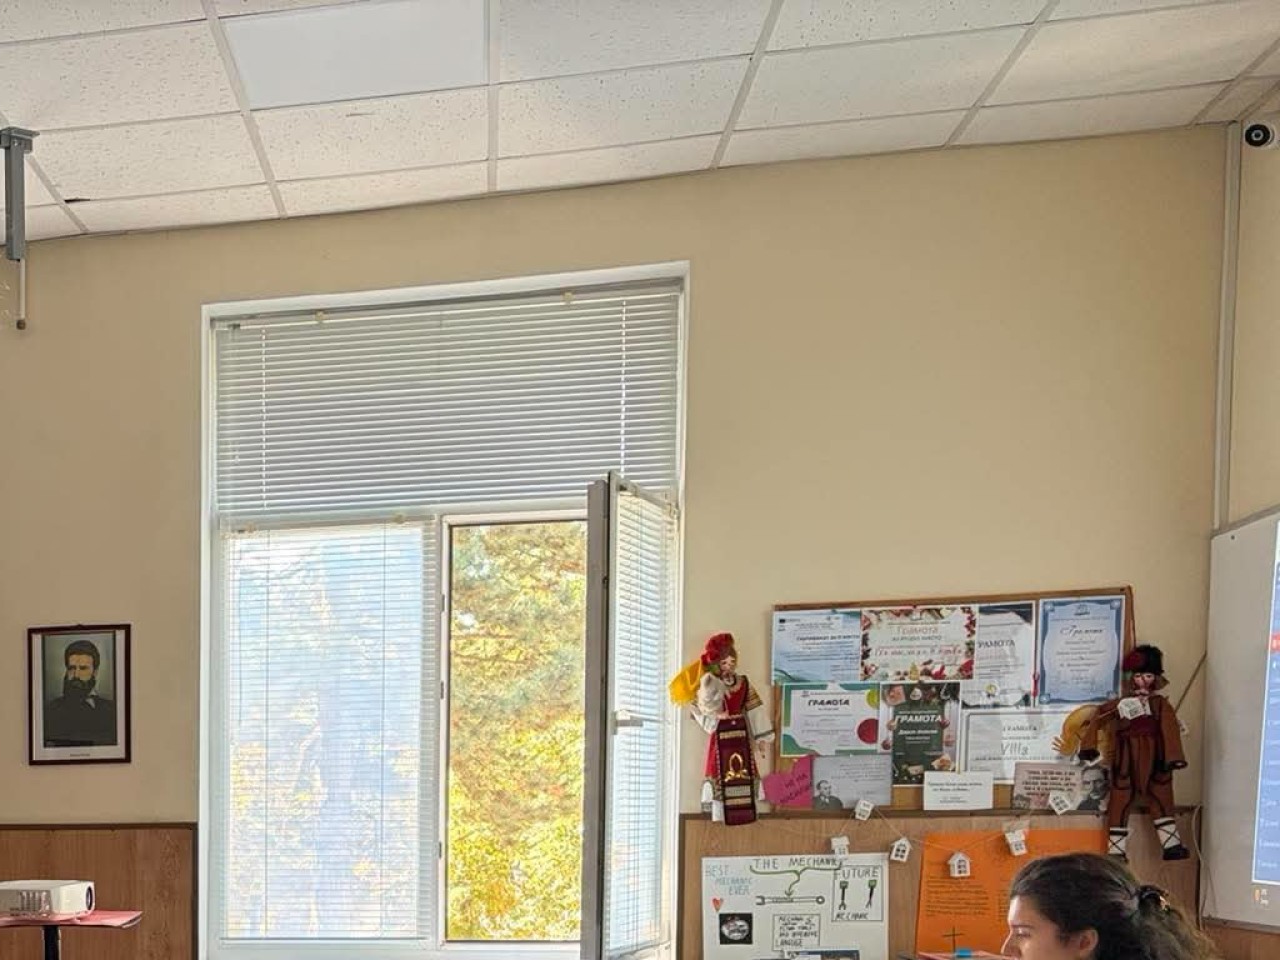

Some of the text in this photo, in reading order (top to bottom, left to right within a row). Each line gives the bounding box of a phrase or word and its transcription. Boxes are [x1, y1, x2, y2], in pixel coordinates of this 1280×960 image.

[978, 639, 1016, 648] РАМОТА
[895, 714, 942, 724] ГРАМОТА
[752, 858, 779, 870] THE
[705, 865, 729, 877] BEST
[833, 866, 879, 880] FUTURE
[729, 885, 751, 896] EVER
